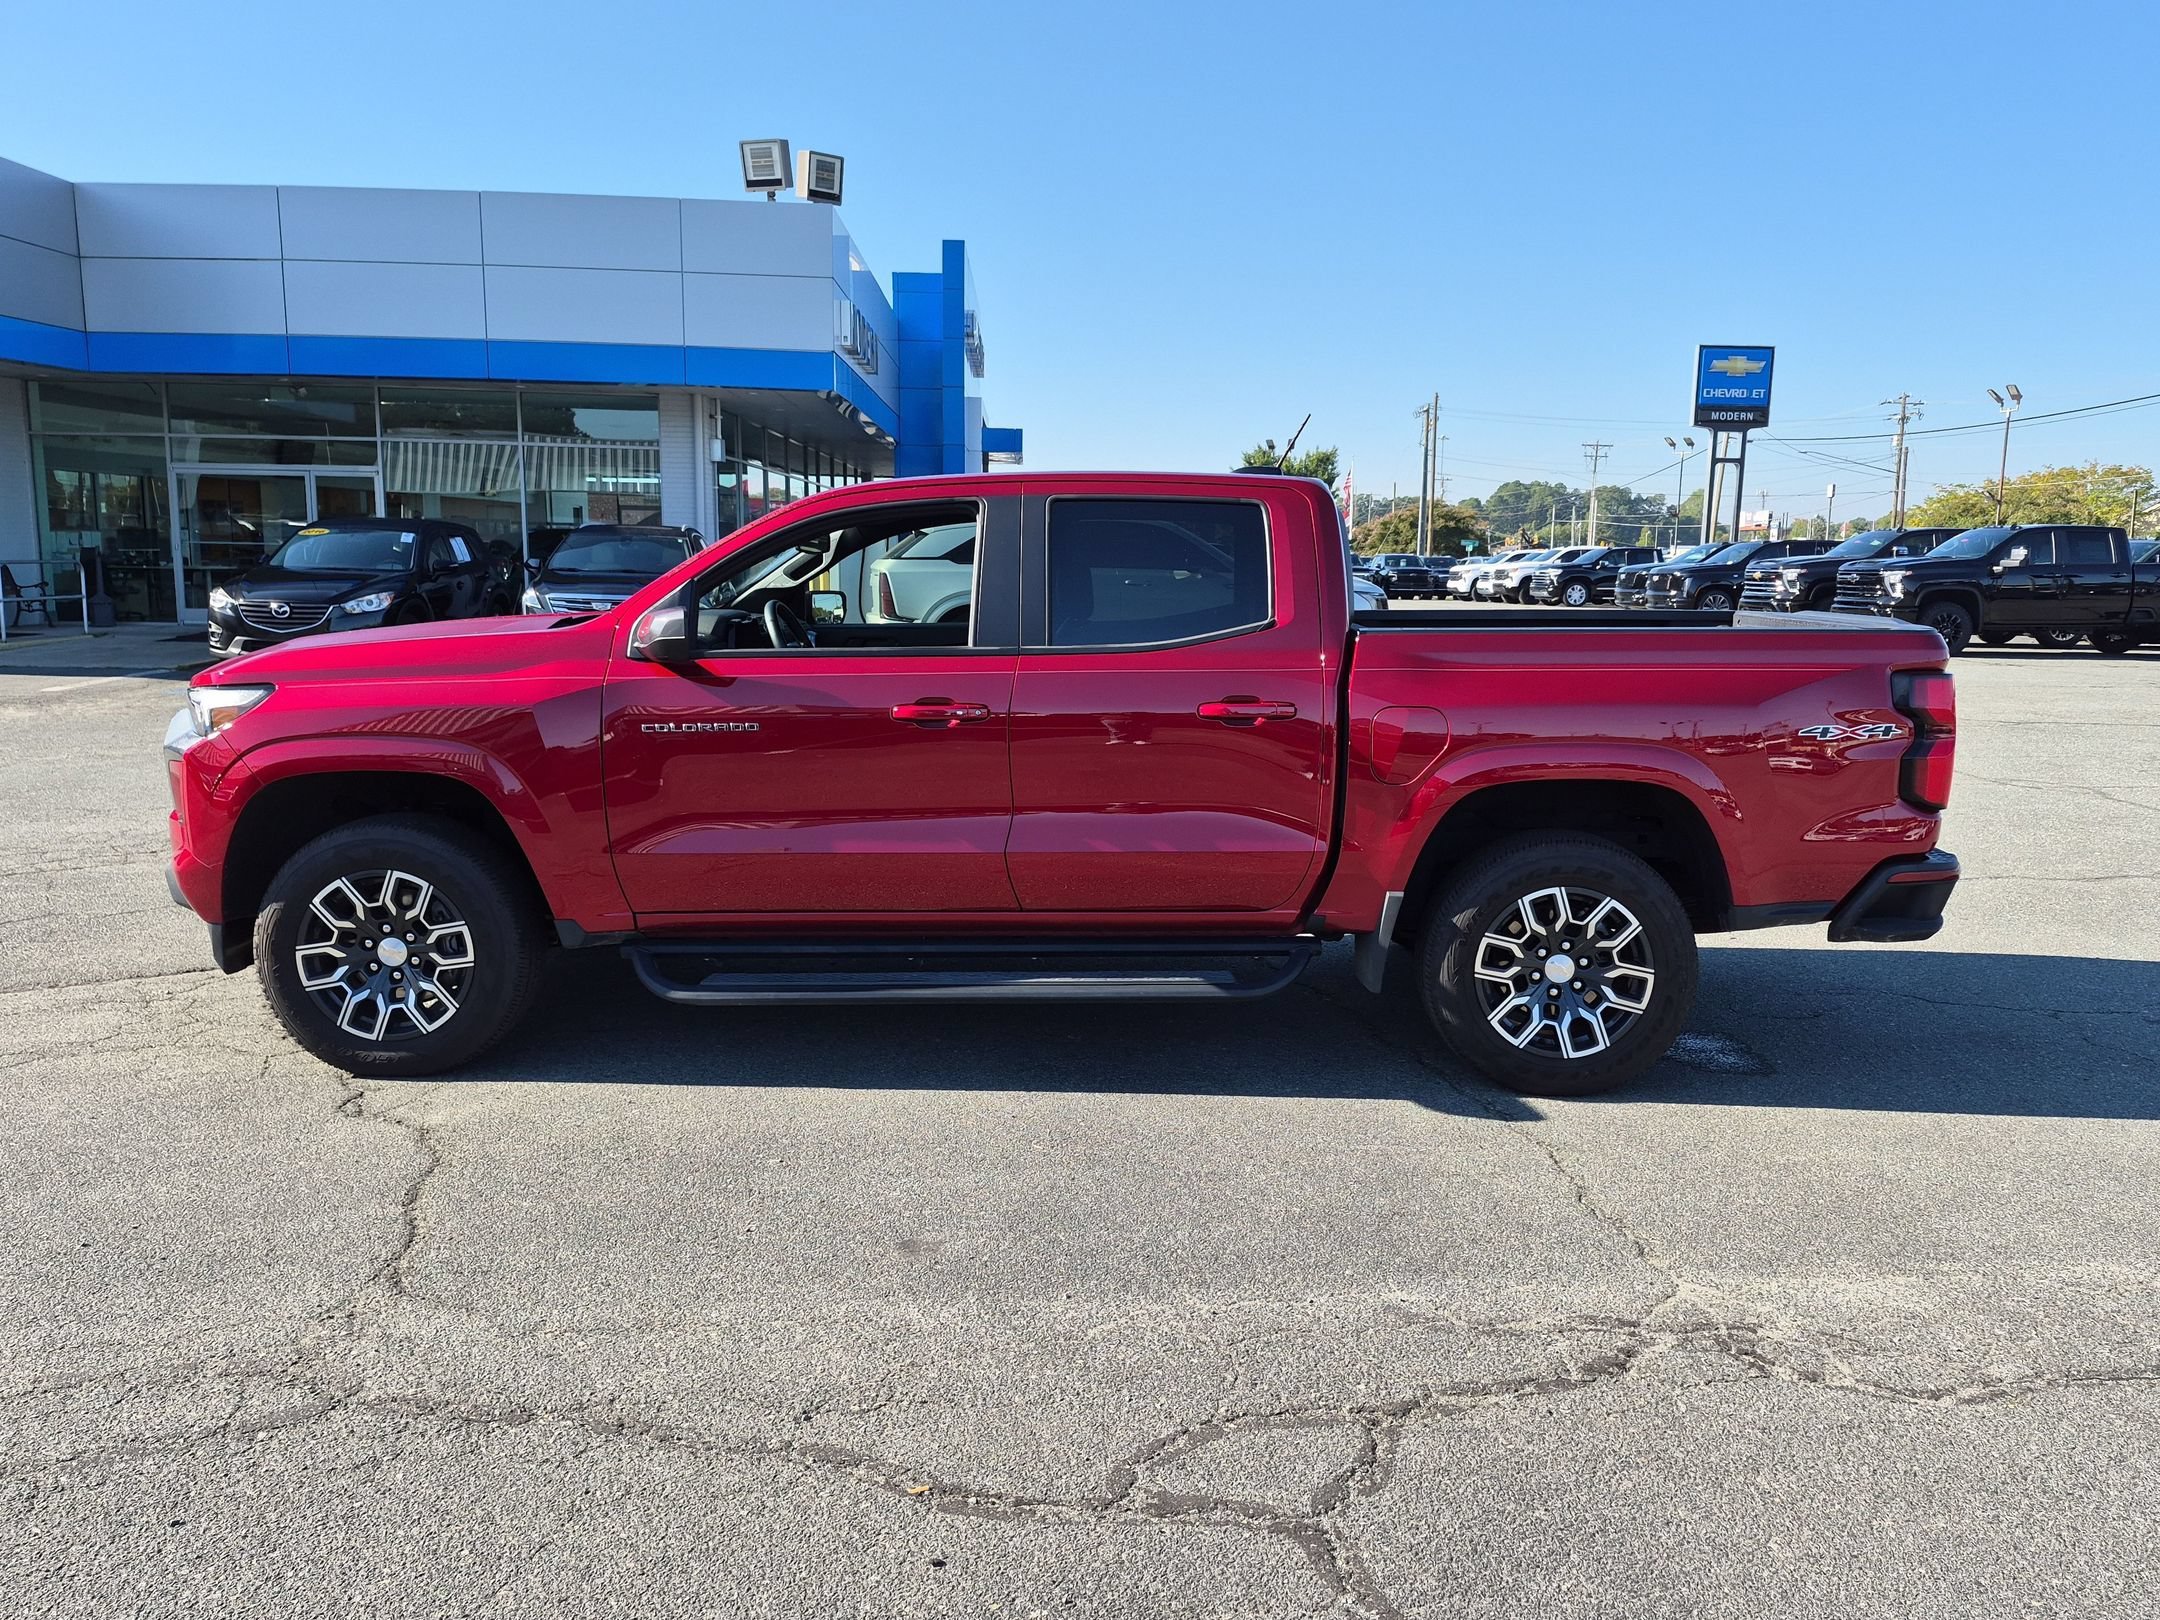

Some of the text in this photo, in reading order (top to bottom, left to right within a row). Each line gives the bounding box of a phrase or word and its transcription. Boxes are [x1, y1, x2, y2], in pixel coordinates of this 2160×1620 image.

[1703, 388, 1766, 398] CHEVROET
[1711, 411, 1754, 421] MODERN
[641, 722, 760, 732] COLORADO
